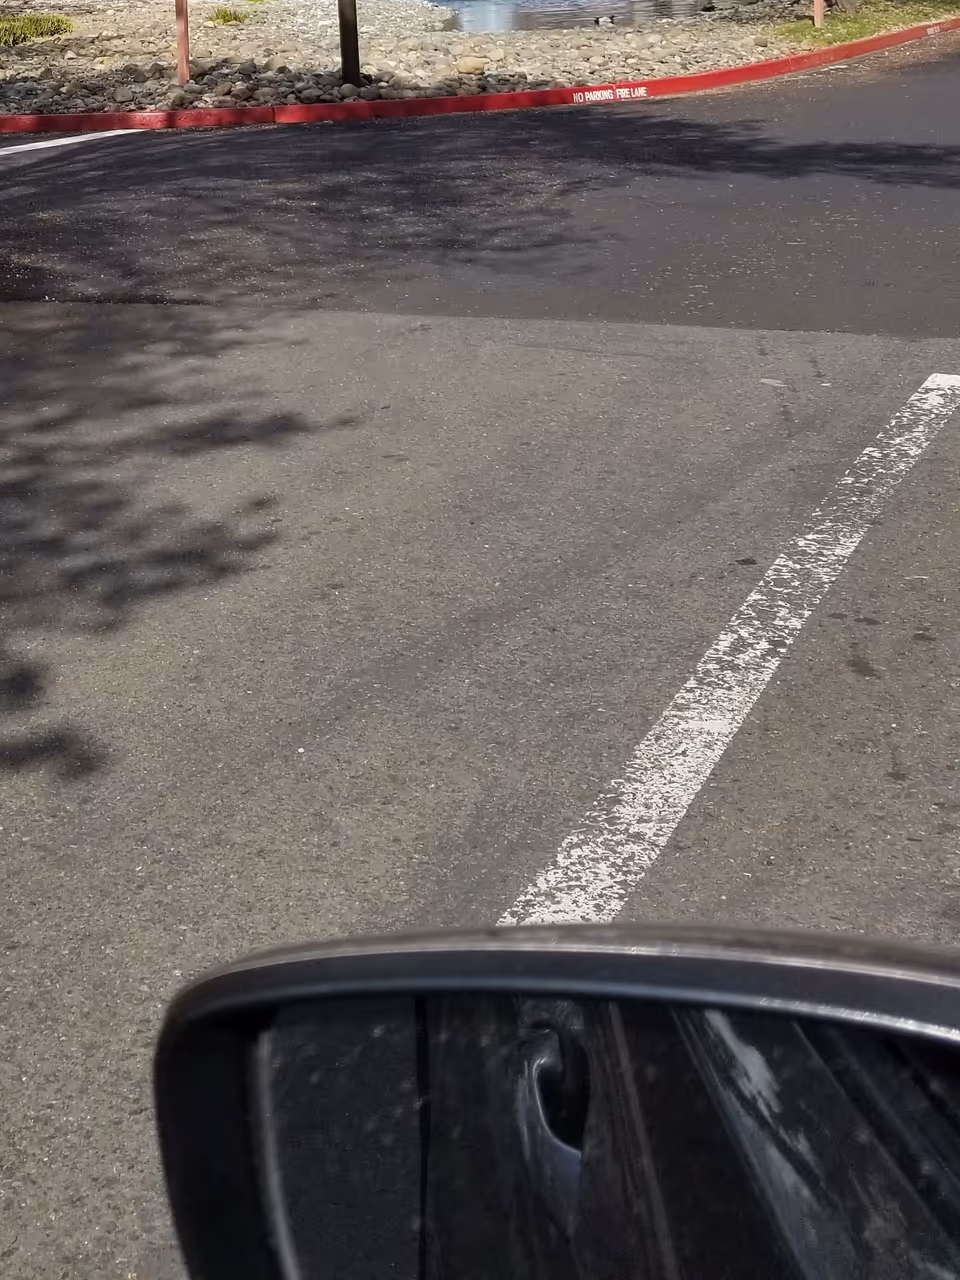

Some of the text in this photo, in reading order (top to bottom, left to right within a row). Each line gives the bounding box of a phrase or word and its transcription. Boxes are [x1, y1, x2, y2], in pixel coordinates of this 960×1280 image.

[573, 86, 647, 103] NO PARKING FIRE LANE
